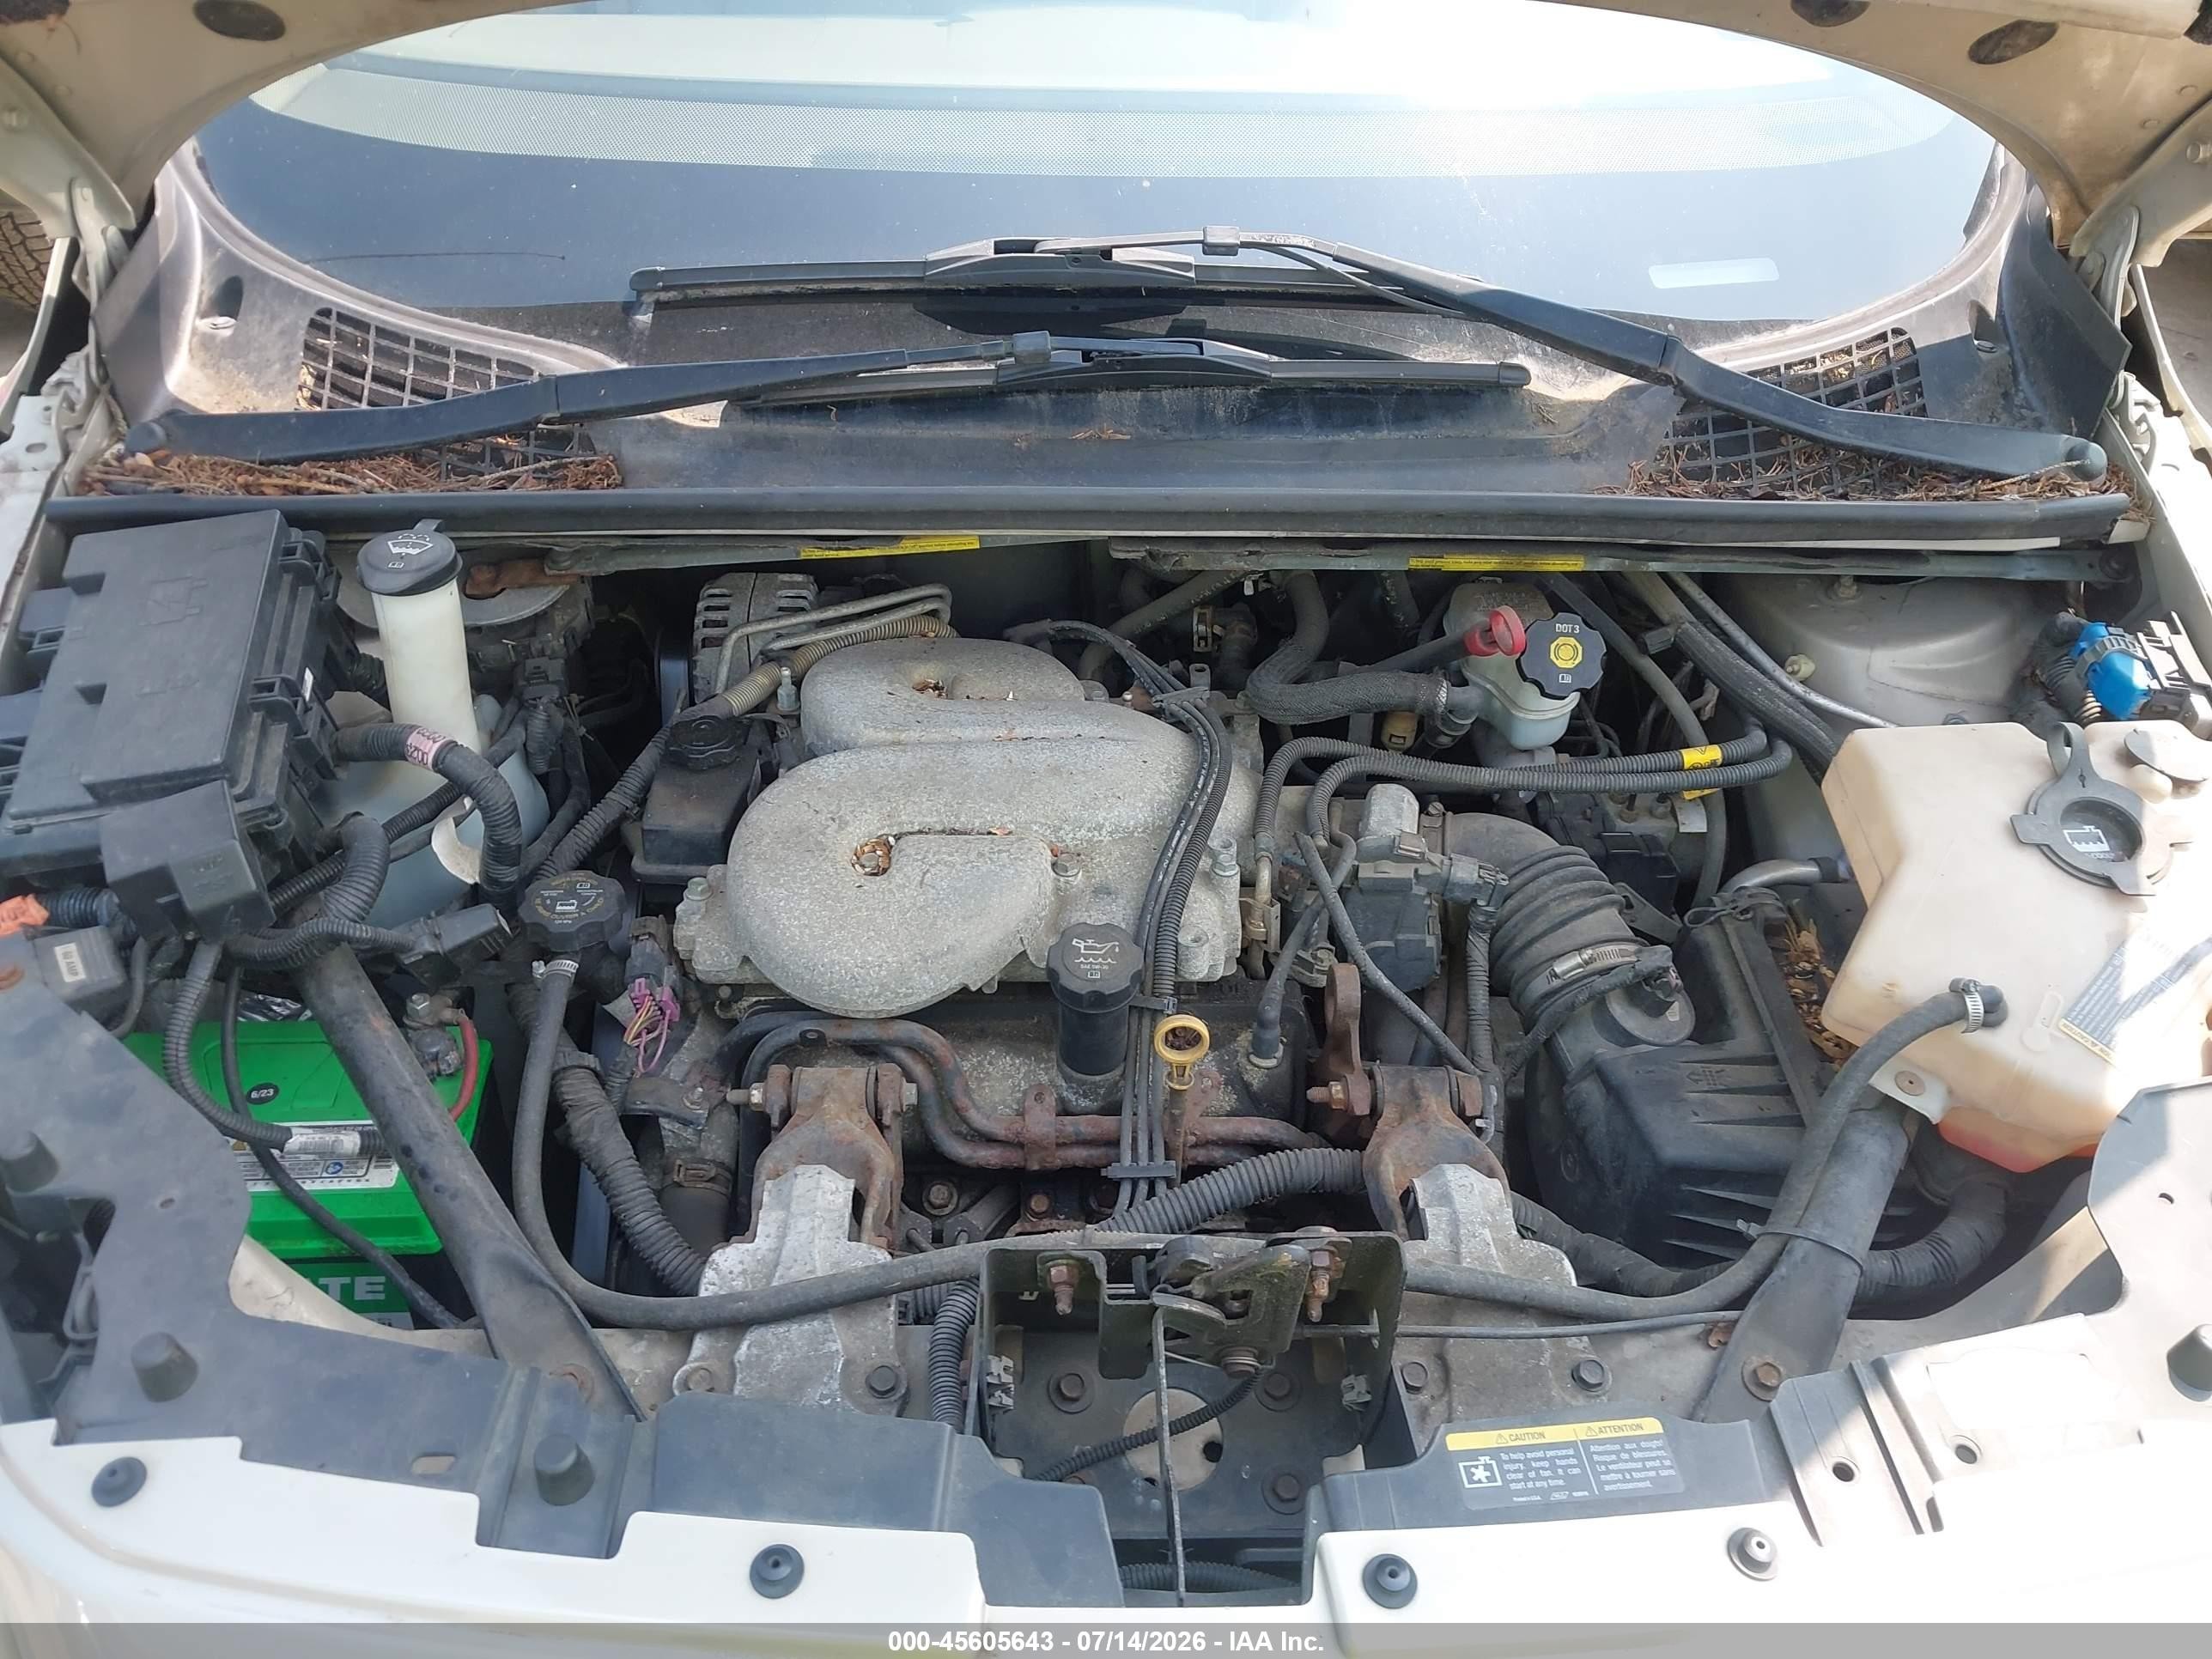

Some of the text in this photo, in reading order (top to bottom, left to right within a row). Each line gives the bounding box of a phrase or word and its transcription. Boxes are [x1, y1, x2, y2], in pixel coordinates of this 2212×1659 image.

[251, 1088, 275, 1099] 6/23
[1598, 1423, 1644, 1435] ATTENTION
[1509, 1431, 1546, 1442] CAUTION
[1546, 1448, 1575, 1457] personal
[1555, 1457, 1578, 1466] hands
